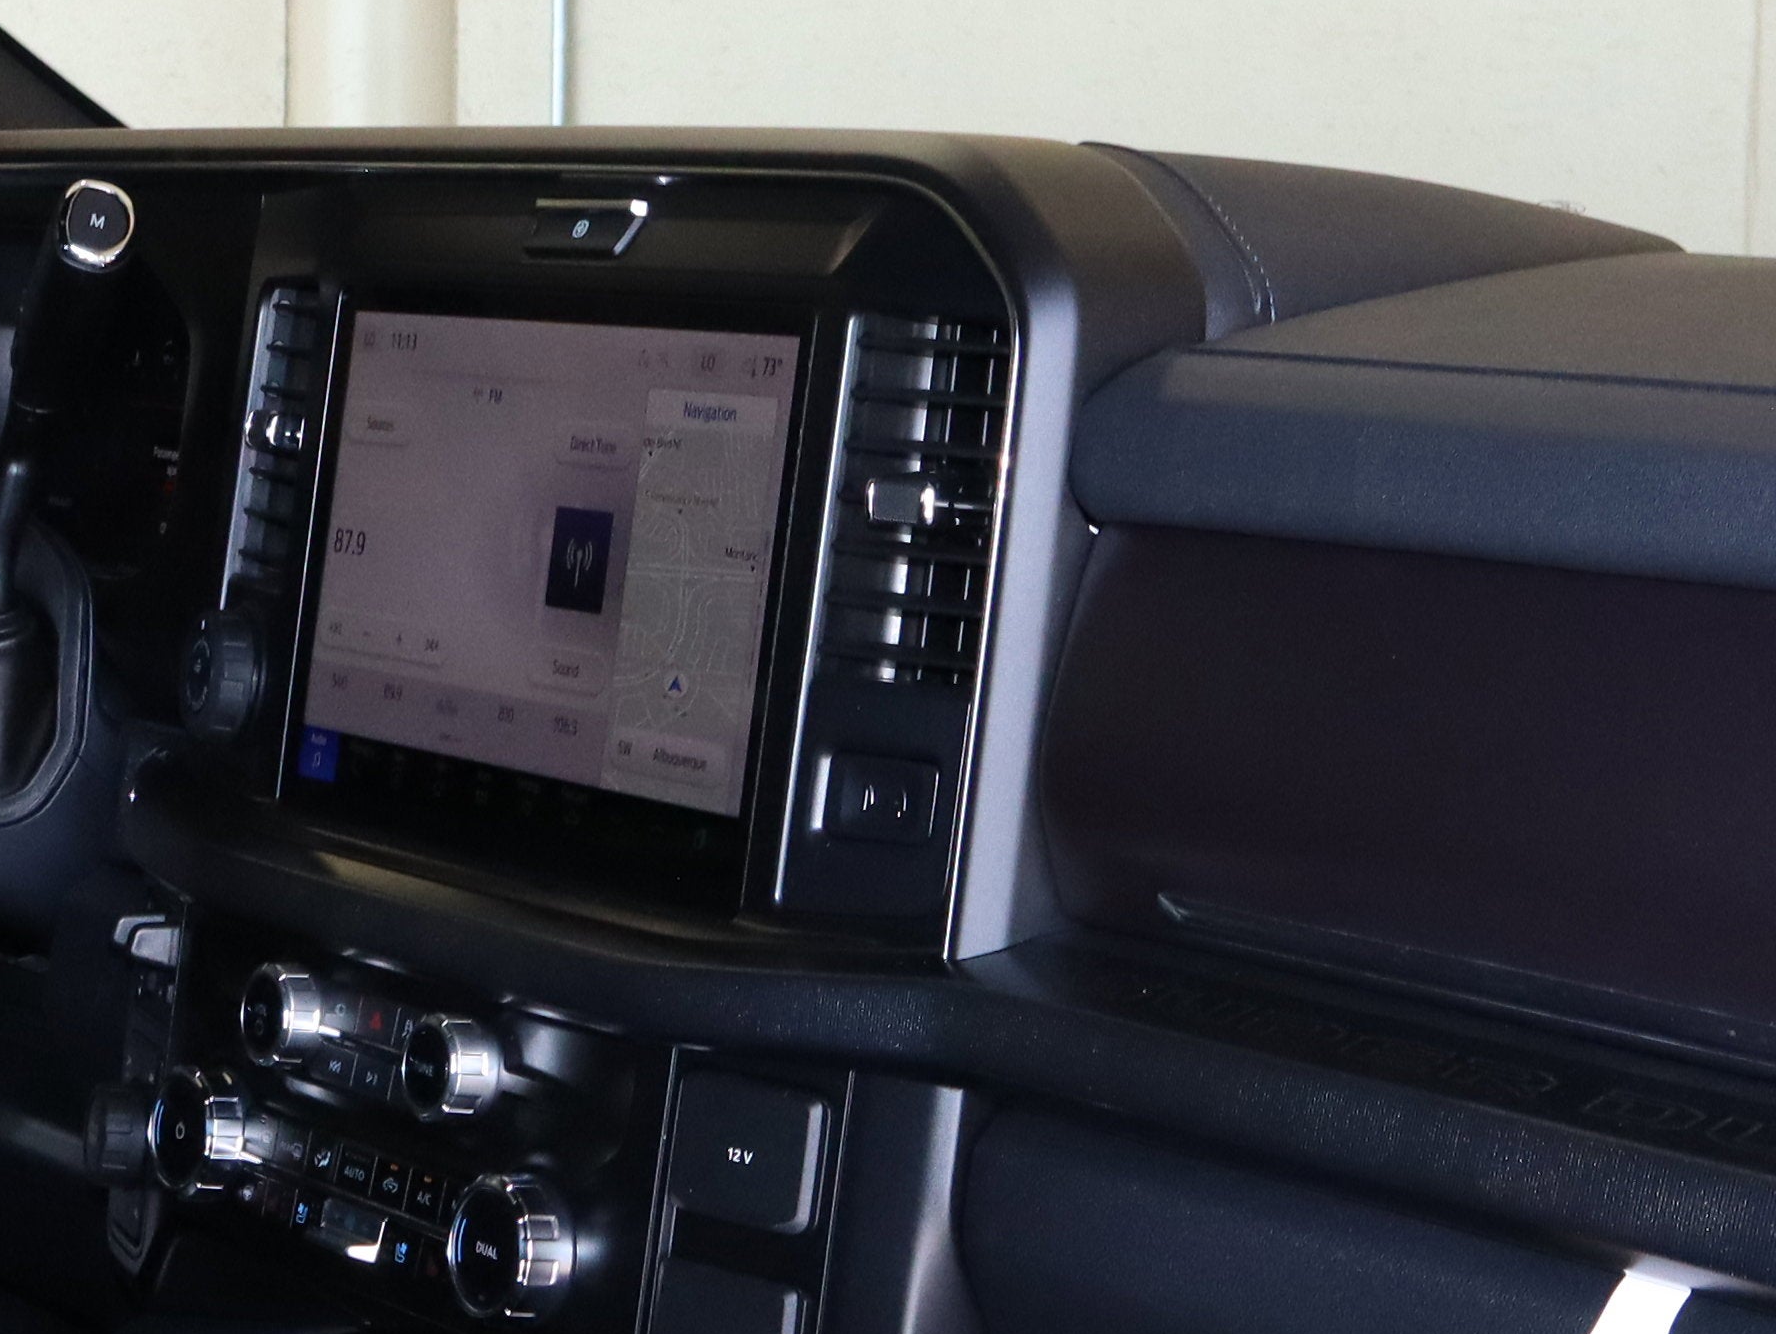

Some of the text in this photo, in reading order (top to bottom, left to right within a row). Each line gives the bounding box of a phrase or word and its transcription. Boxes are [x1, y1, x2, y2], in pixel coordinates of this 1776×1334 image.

[89, 213, 105, 230] M
[683, 402, 737, 423] Navigation
[334, 528, 367, 556] 87.9
[727, 1147, 754, 1165] 12 V
[344, 1166, 365, 1182] AUTO
[417, 1191, 432, 1207] A/C
[475, 1240, 498, 1261] DUAL
